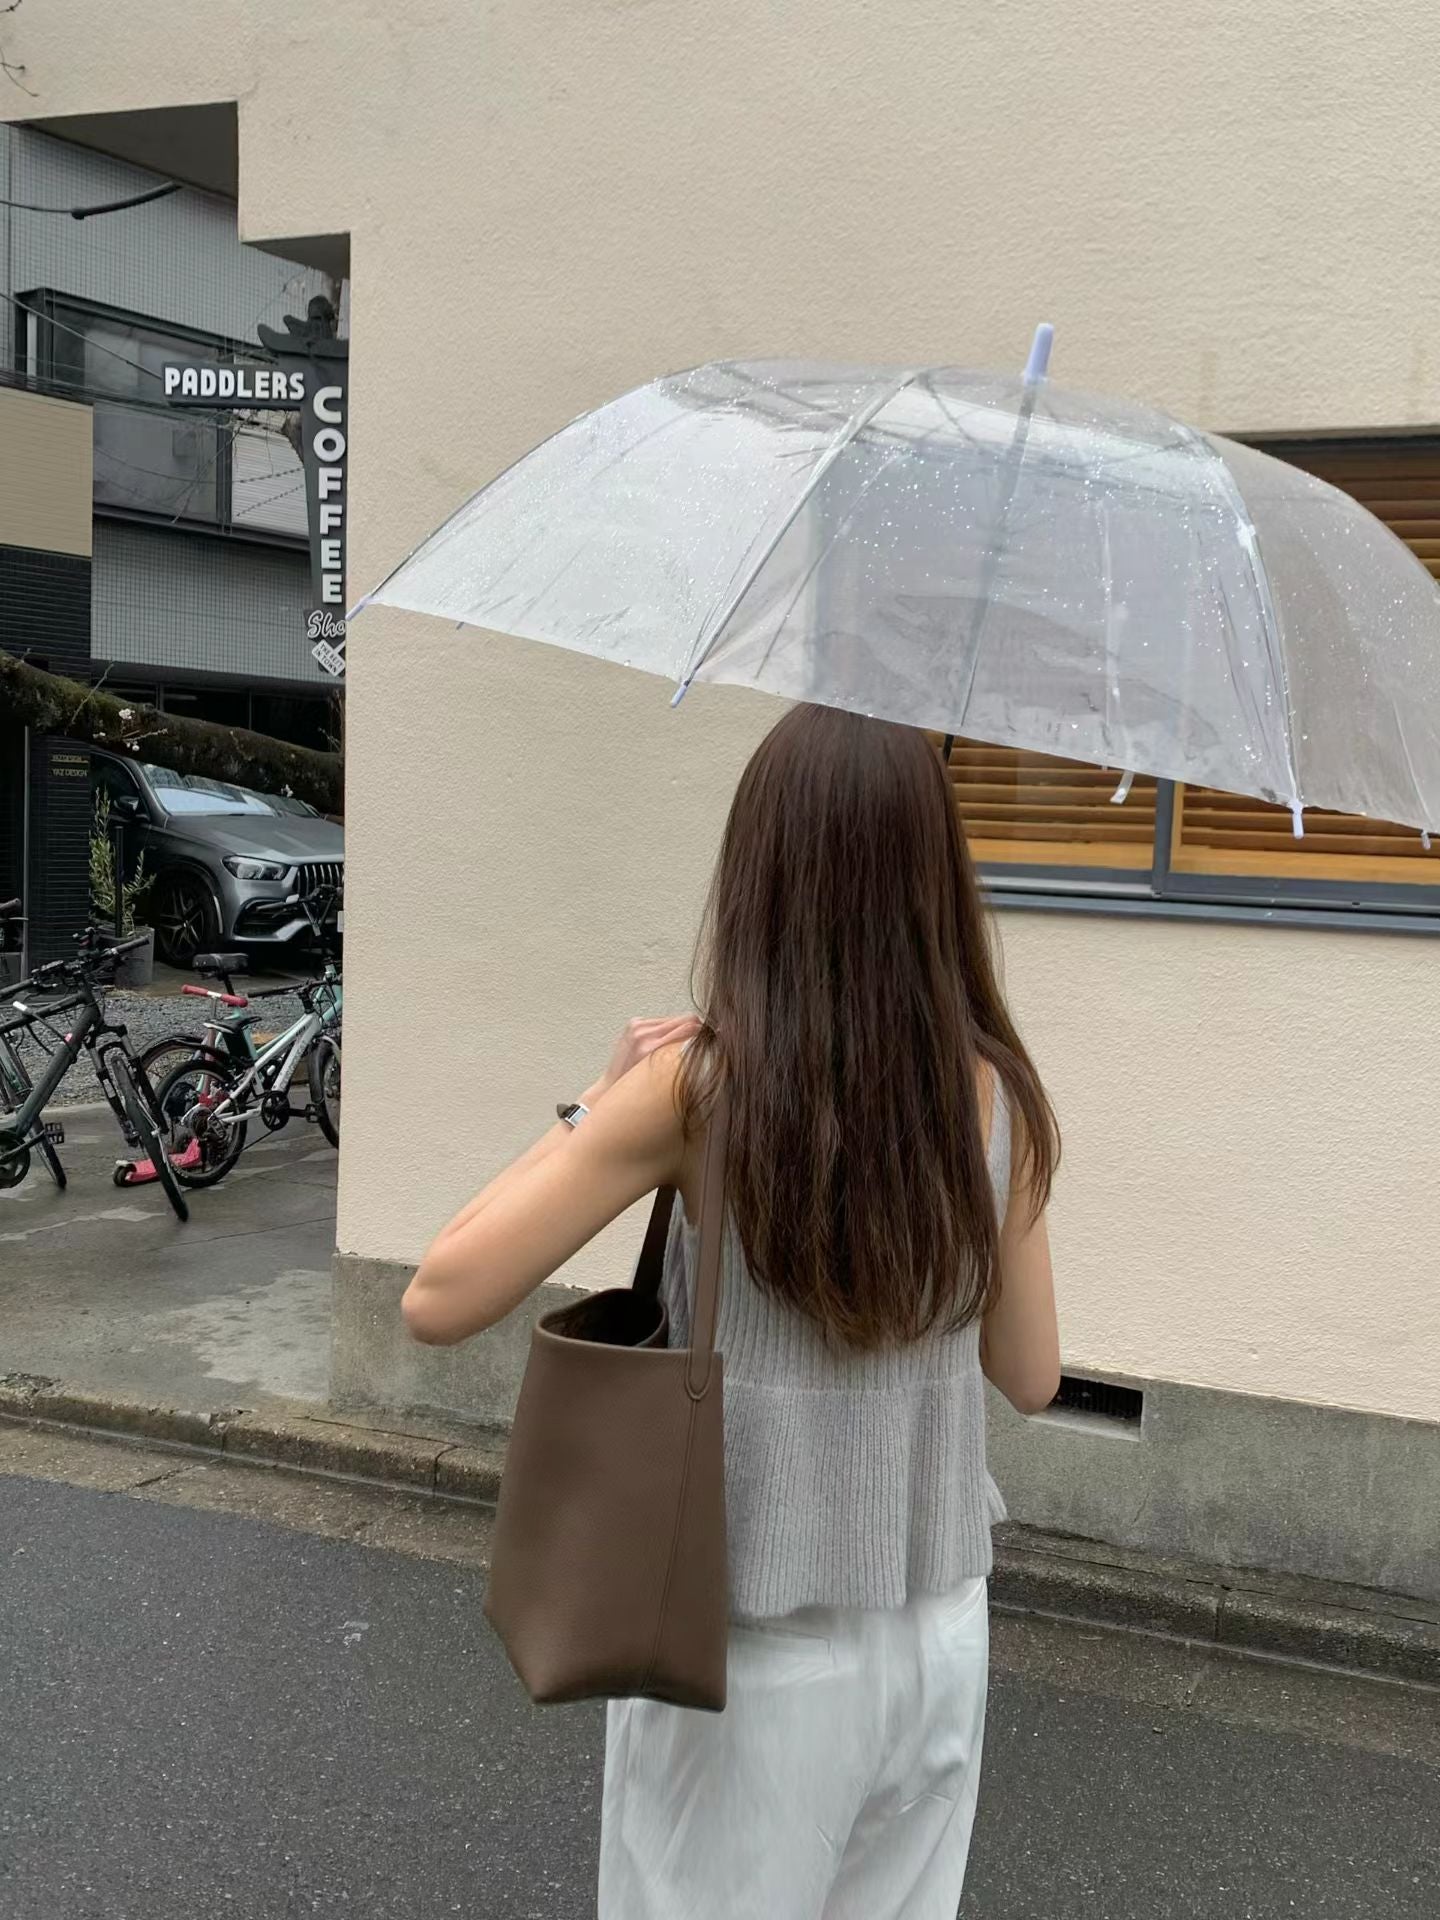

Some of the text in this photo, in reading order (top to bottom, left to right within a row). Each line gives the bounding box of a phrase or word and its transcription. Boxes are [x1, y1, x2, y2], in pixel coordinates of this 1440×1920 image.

[164, 367, 305, 400] PADDLERS
[313, 386, 346, 604] COFFEE
[321, 656, 338, 673] TOWN
